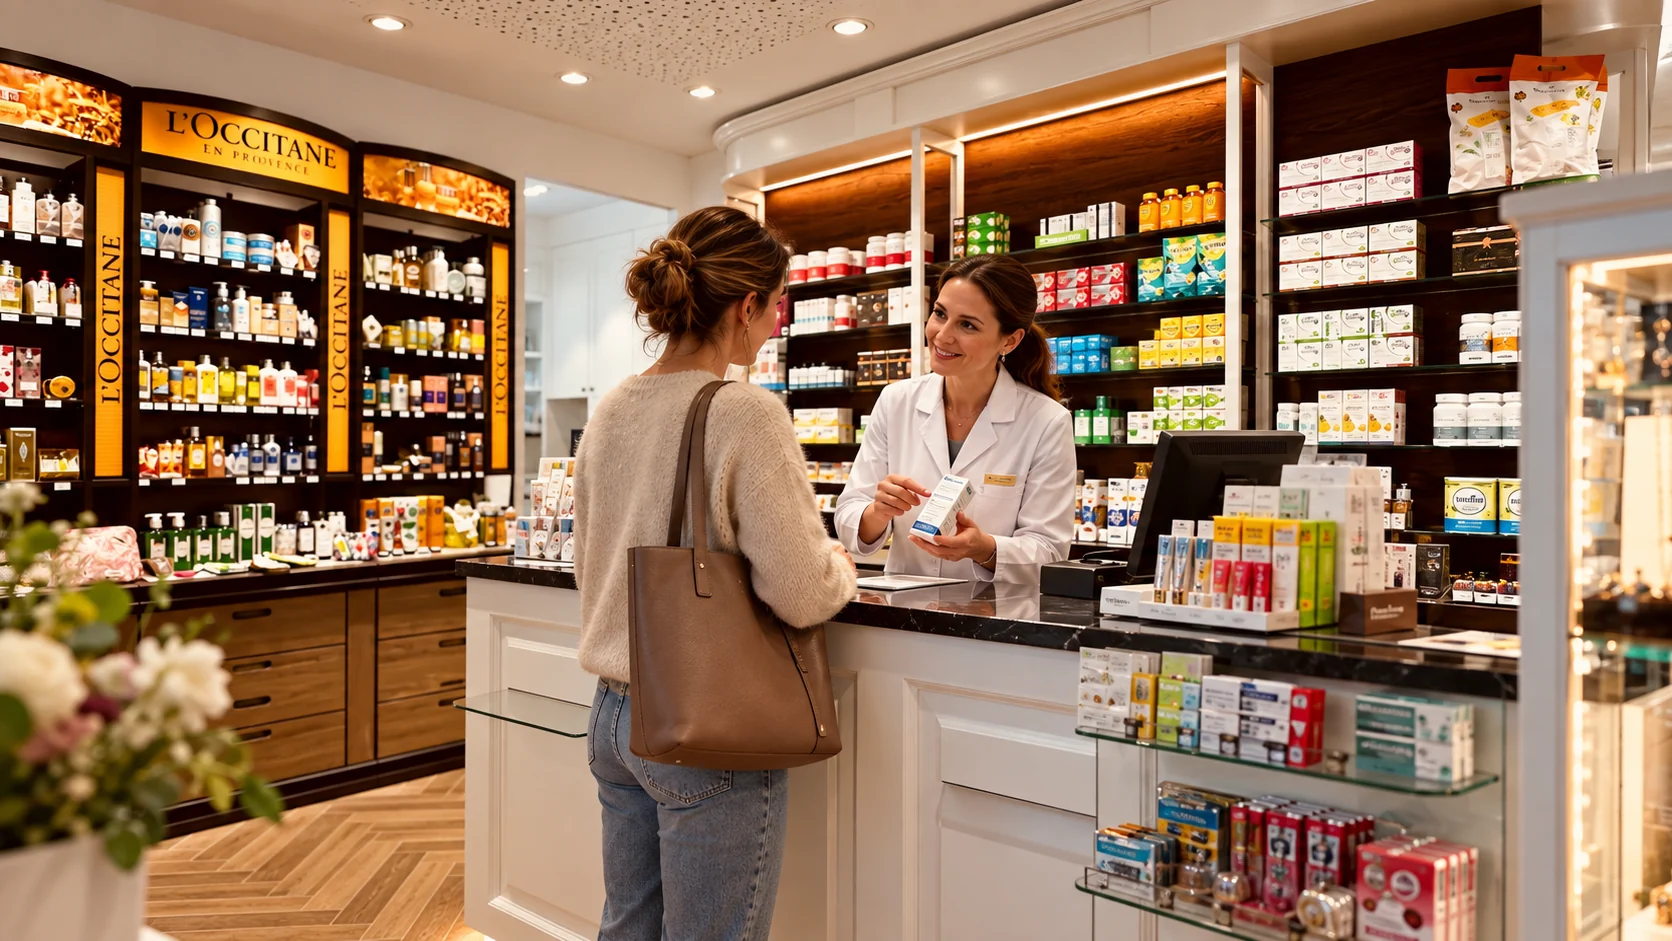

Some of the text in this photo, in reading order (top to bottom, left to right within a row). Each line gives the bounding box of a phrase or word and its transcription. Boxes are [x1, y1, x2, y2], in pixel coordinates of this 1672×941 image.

[166, 110, 337, 169] L'OCCITANE
[203, 143, 223, 156] EN
[98, 235, 121, 404] L'OCCITANE
[330, 269, 348, 410] L'OCCITANE
